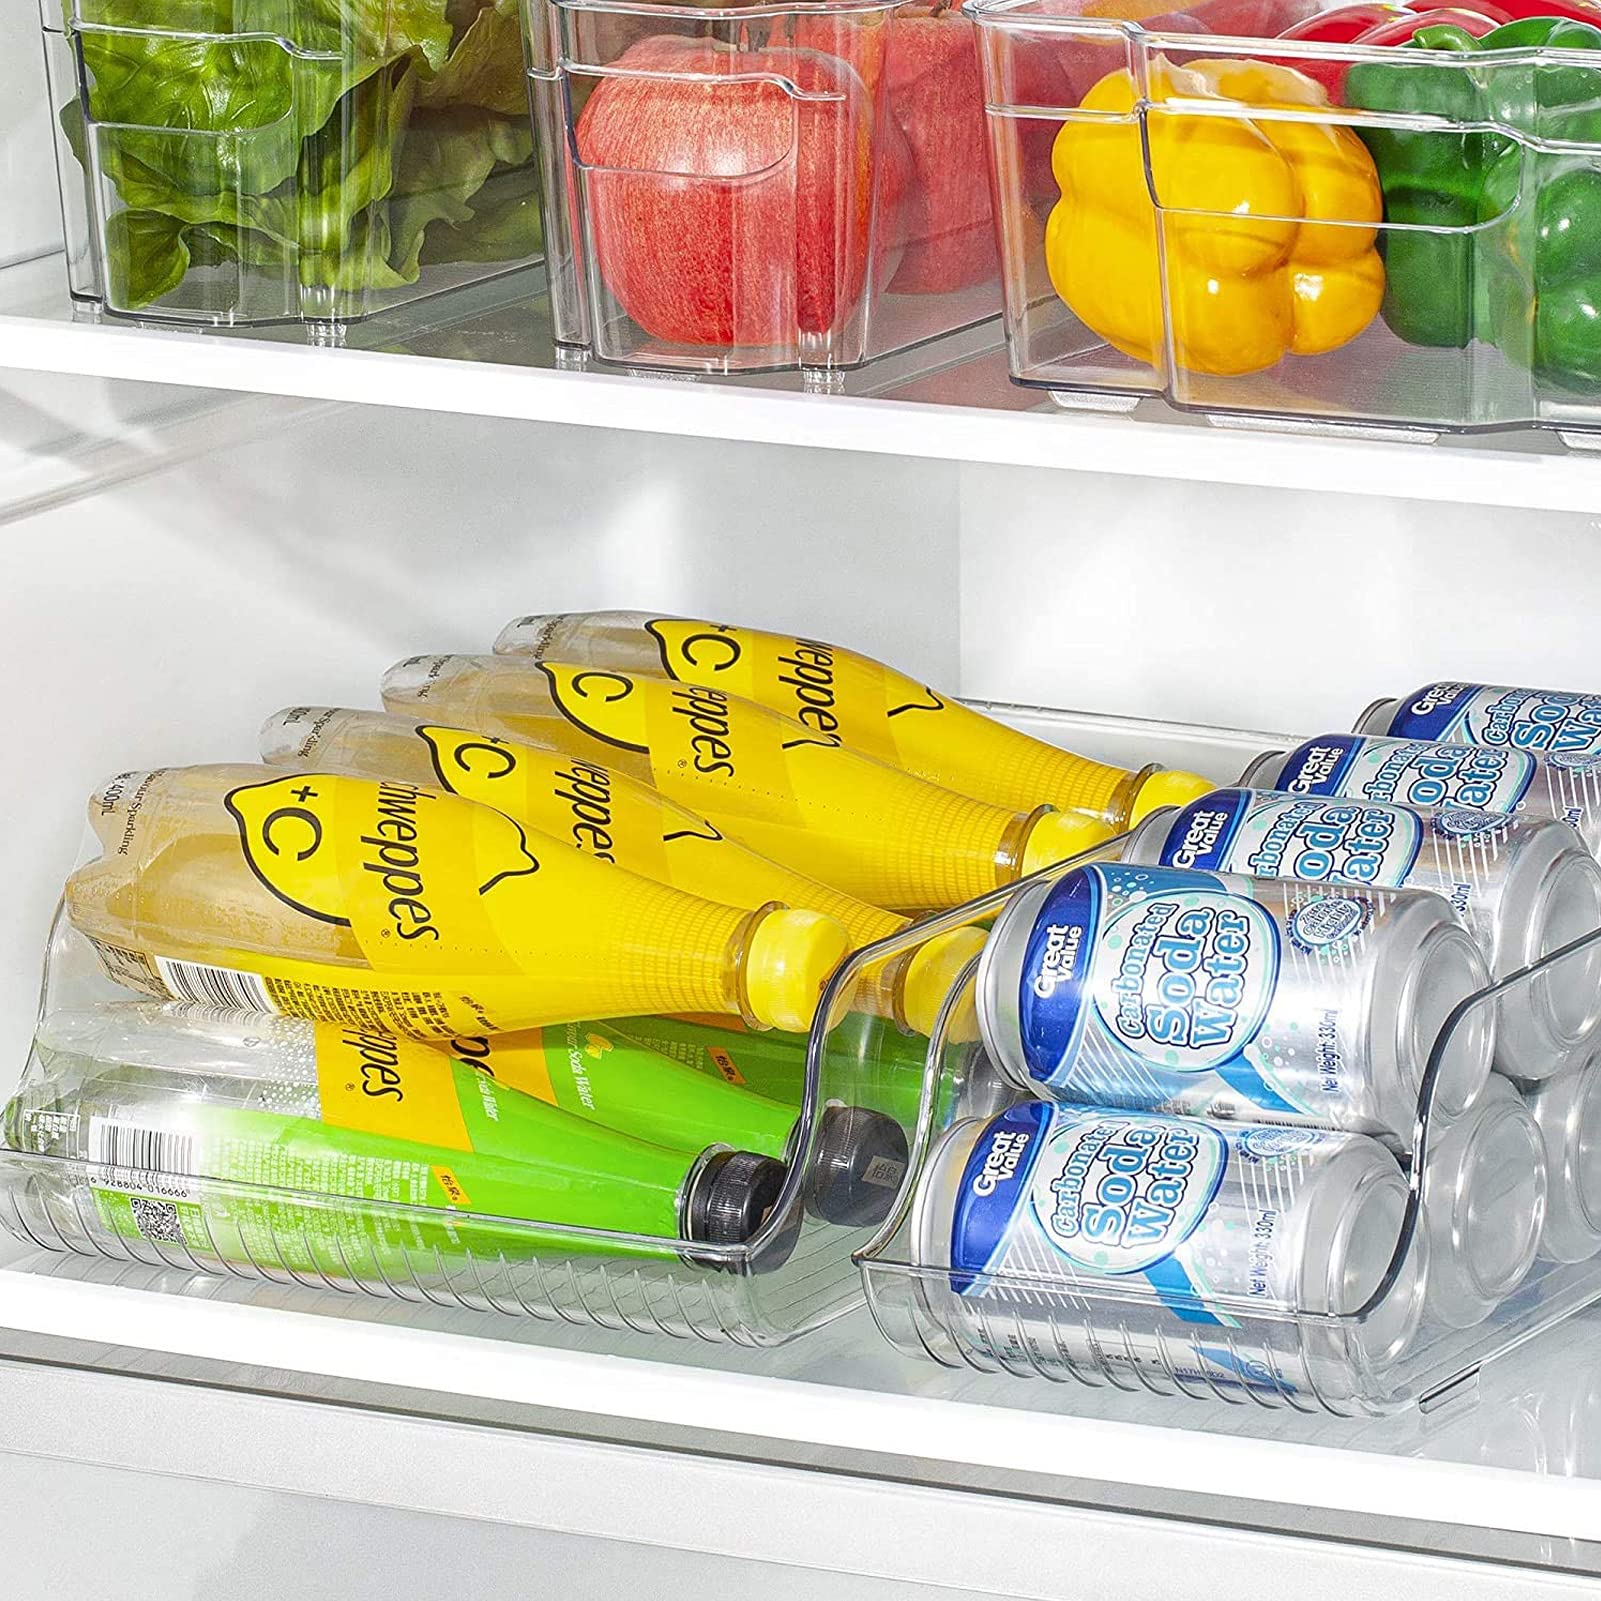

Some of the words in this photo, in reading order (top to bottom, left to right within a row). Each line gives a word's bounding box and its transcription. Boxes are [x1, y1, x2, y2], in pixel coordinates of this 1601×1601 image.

[1411, 684, 1449, 715] Gre
[1311, 747, 1343, 785] Value
[1412, 745, 1470, 805] oda
[1450, 749, 1508, 808] ater
[117, 802, 143, 856] Sparkling
[1172, 809, 1215, 869] Great
[1194, 811, 1229, 856] Value
[1250, 802, 1326, 877] rbonated
[1296, 806, 1360, 879] oda
[1341, 808, 1395, 882] ater
[1034, 923, 1069, 999] Great
[1056, 925, 1083, 983] Value
[1112, 902, 1179, 1037] Carbonated
[1147, 907, 1216, 1045] Soda
[1189, 909, 1250, 1048] Water
[973, 1130, 1018, 1197] Great
[997, 1133, 1031, 1182] Value
[1081, 1126, 1166, 1246] Soda
[1120, 1128, 1201, 1249] Water
[1253, 1209, 1277, 1240] 330ml
[1250, 1277, 1267, 1297] Net
